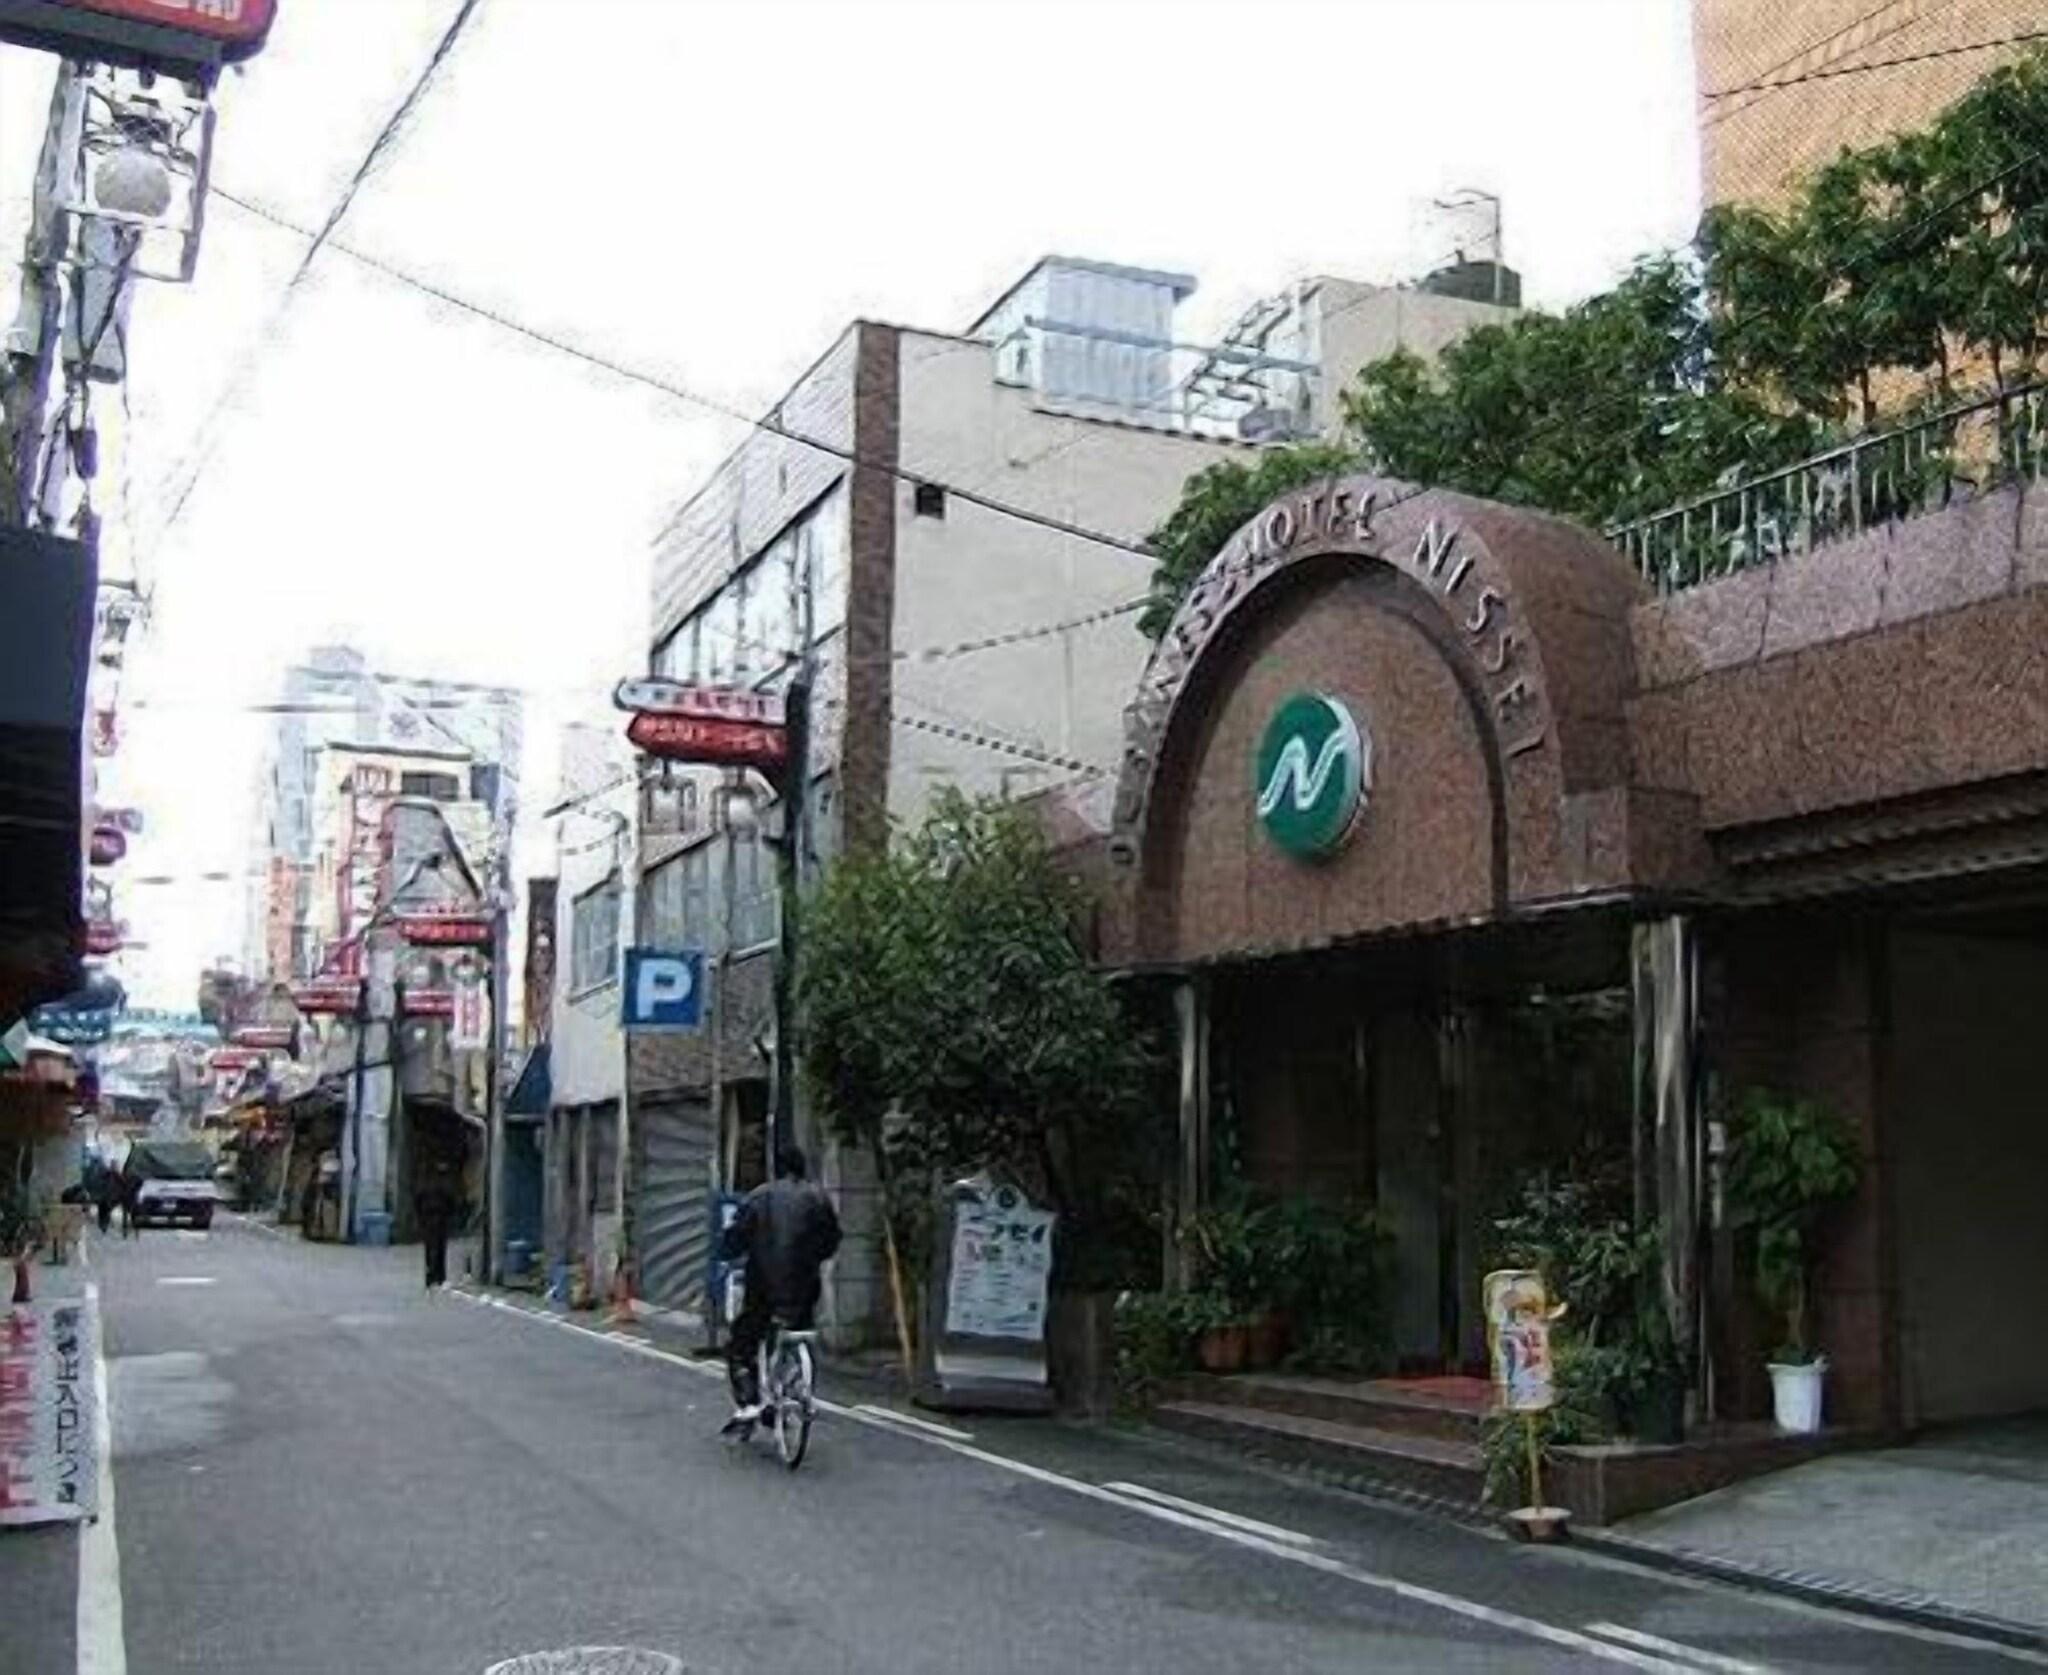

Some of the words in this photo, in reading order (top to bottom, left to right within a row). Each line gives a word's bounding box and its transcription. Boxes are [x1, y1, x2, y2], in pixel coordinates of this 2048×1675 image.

[1214, 490, 1377, 578] HOTEL
[1411, 518, 1547, 759] NISSEI
[636, 958, 693, 1020] P
